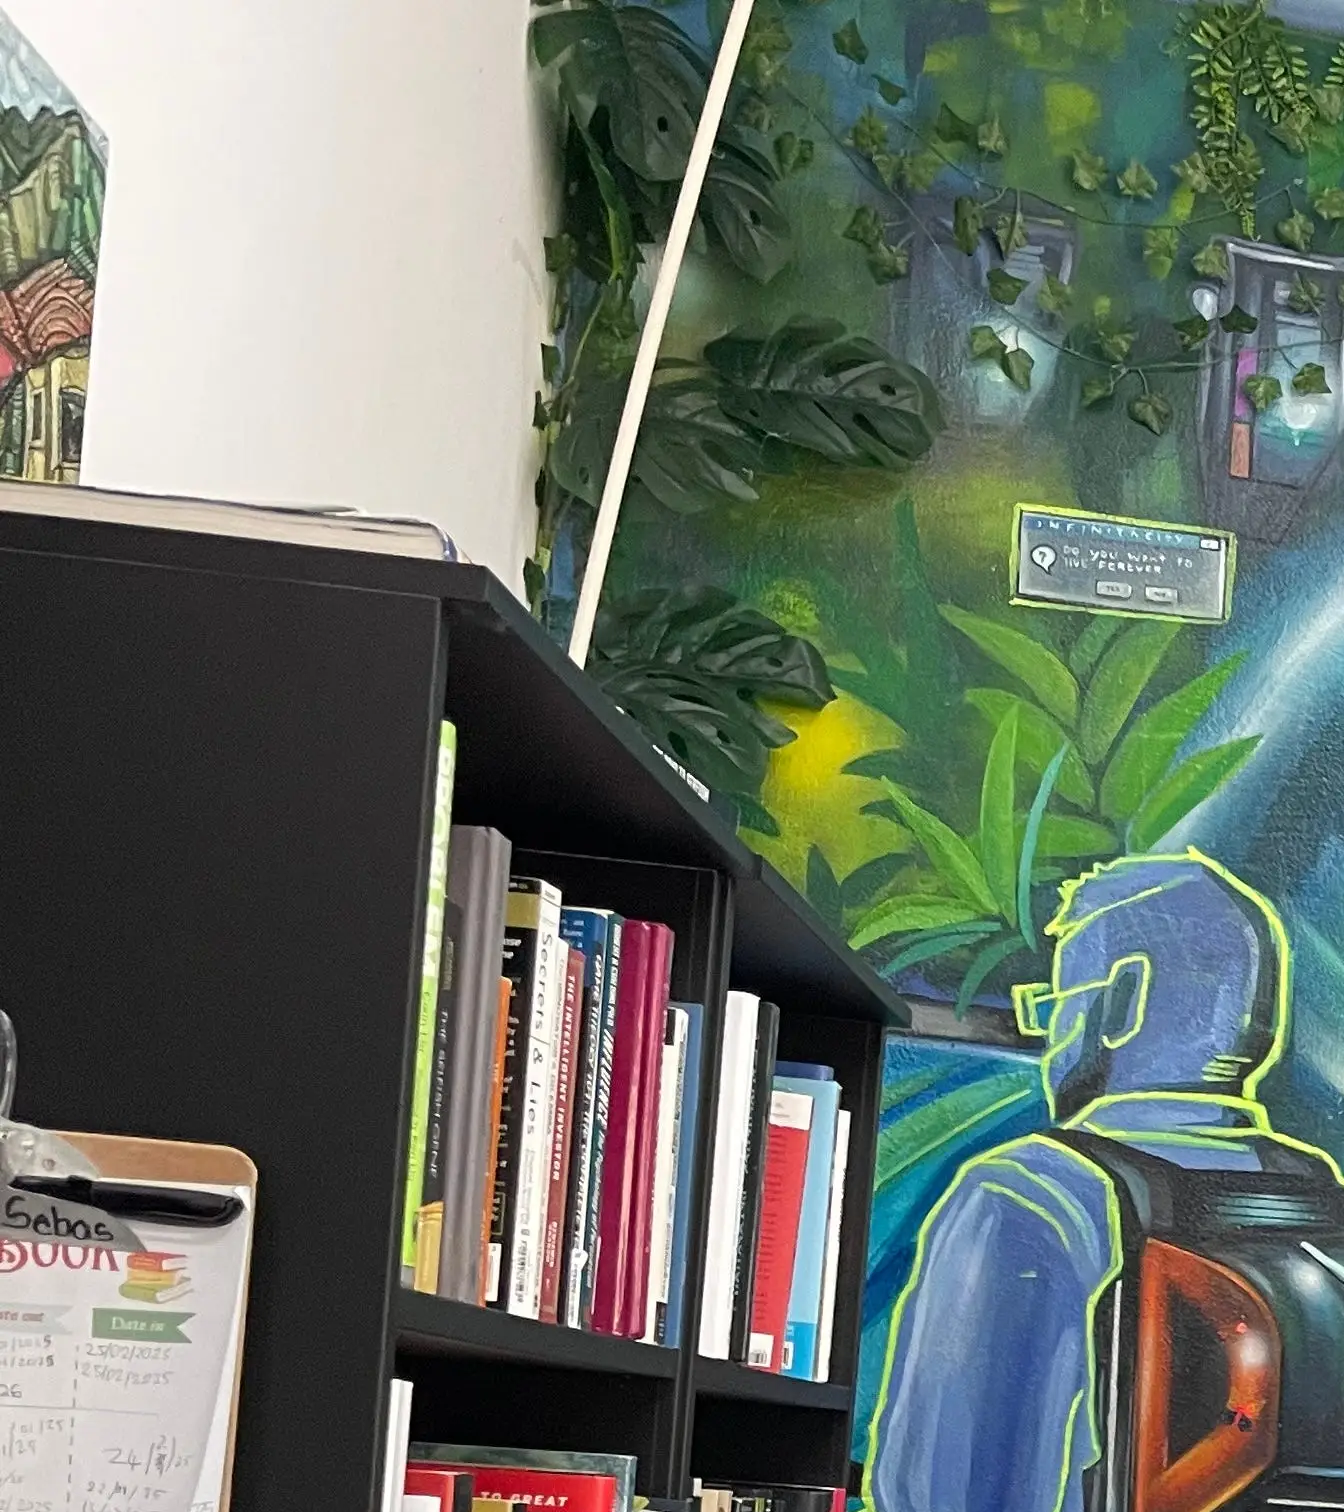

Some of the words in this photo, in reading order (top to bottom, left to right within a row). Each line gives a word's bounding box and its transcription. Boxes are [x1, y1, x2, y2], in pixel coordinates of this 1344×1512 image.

[534, 932, 552, 1030] Secrets
[564, 975, 576, 1001] THE
[532, 1047, 544, 1065] &
[558, 1005, 574, 1102] INTELLIGENT
[597, 1029, 615, 1126] INFLUENCE
[527, 1081, 541, 1135] Lies
[551, 1107, 566, 1181] INVESTOR
[111, 1316, 149, 1330] Date
[511, 1493, 569, 1509] GREAT
